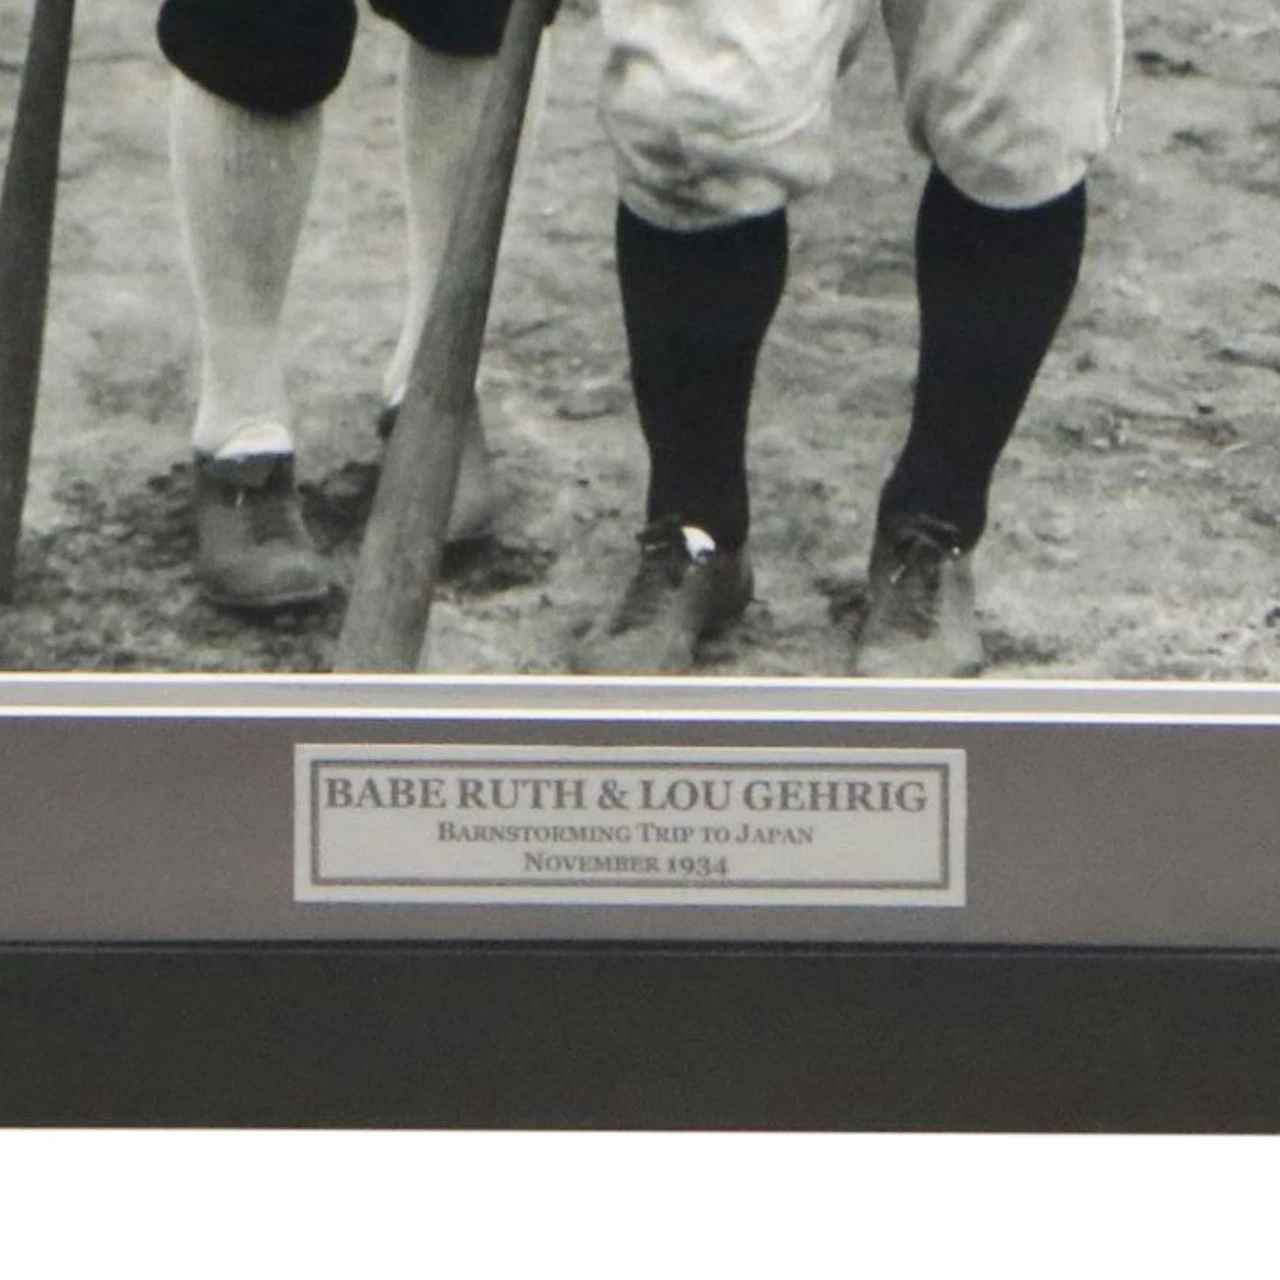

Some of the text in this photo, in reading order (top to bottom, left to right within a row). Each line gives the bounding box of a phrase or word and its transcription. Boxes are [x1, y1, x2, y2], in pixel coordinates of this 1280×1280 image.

[323, 776, 928, 813] BABE RUTH & LOU GEHRIG
[436, 820, 815, 845] BARNSTORMING TRIP TO JAPAN
[523, 851, 729, 877] NOVEMBER 1934
